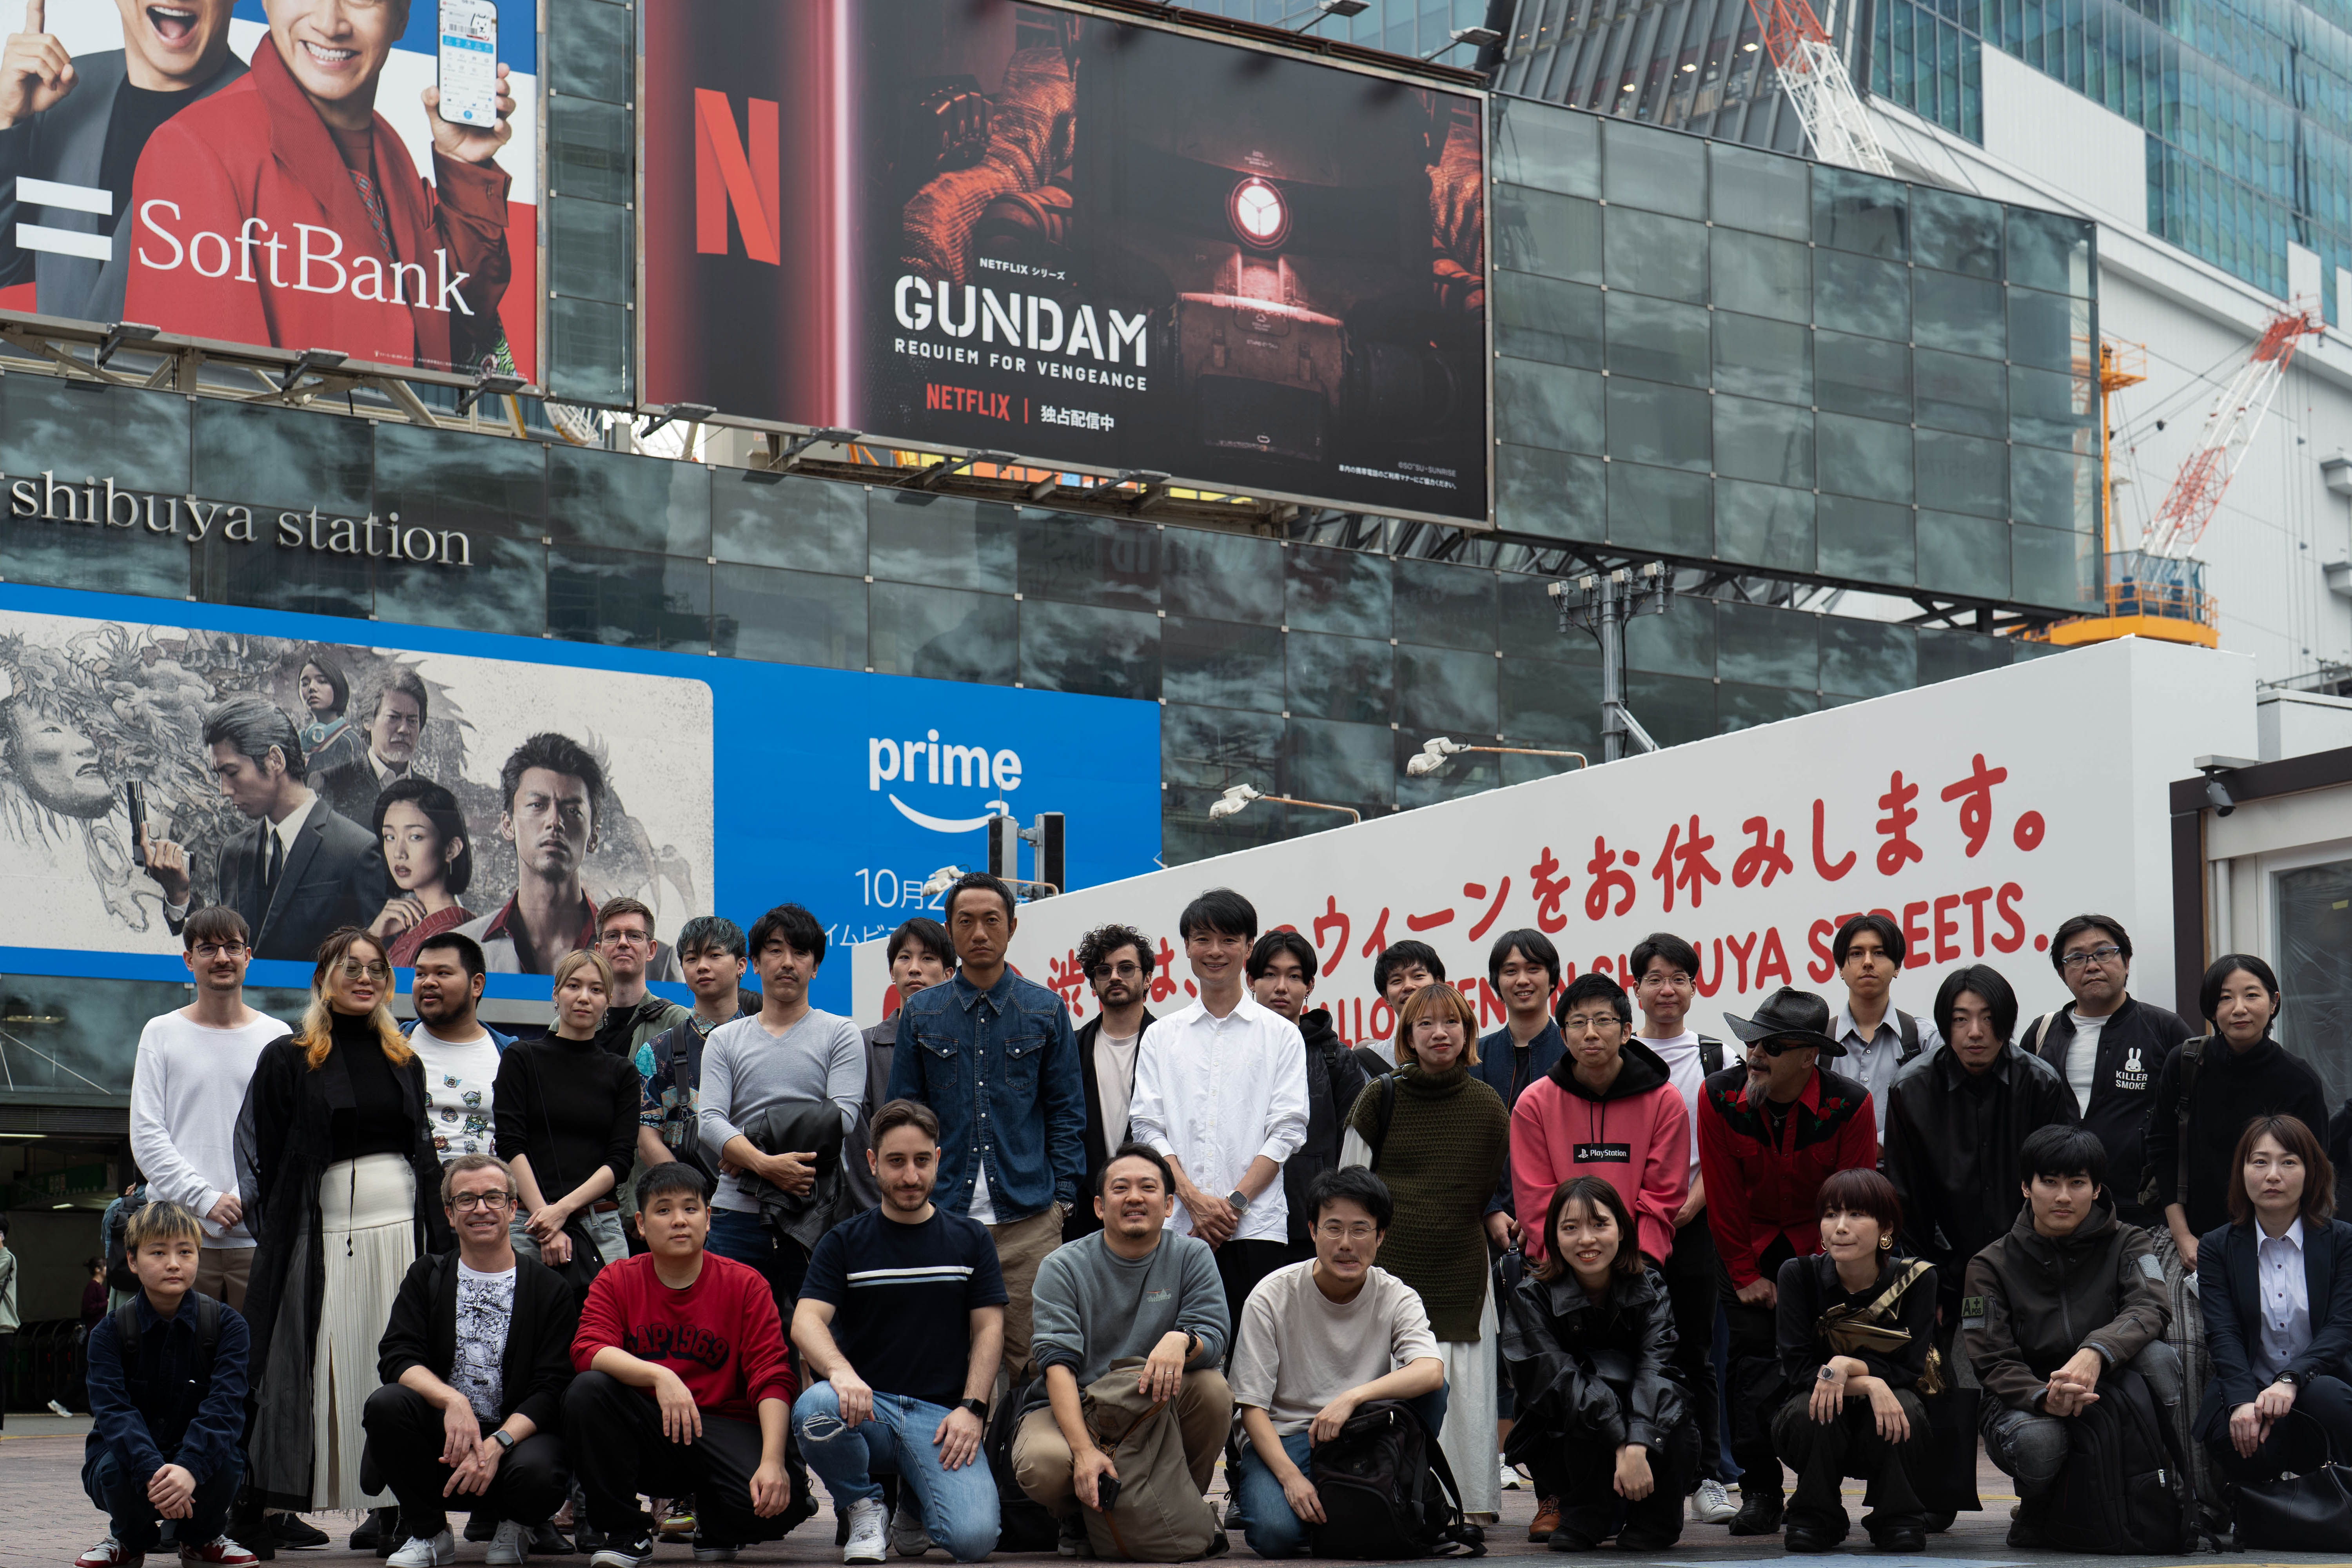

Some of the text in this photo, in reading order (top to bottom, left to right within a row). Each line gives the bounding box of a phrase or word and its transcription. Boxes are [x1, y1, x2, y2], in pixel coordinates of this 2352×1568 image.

[138, 198, 475, 316] SoftBank
[980, 258, 1066, 280] NETFLIX シリーズ
[895, 275, 1147, 367] GUNDAM
[895, 338, 1147, 392] REQUIEM FOR VENGEANCE
[926, 383, 1114, 432] NETFLIX 独占配信中
[11, 469, 474, 566] shibuya station
[869, 728, 1022, 791] prime
[1808, 882, 2049, 984] SEETS.
[2116, 1071, 2148, 1081] KILLER
[2116, 1080, 2147, 1090] SMOKE
[1590, 1149, 1627, 1158] PlayStation
